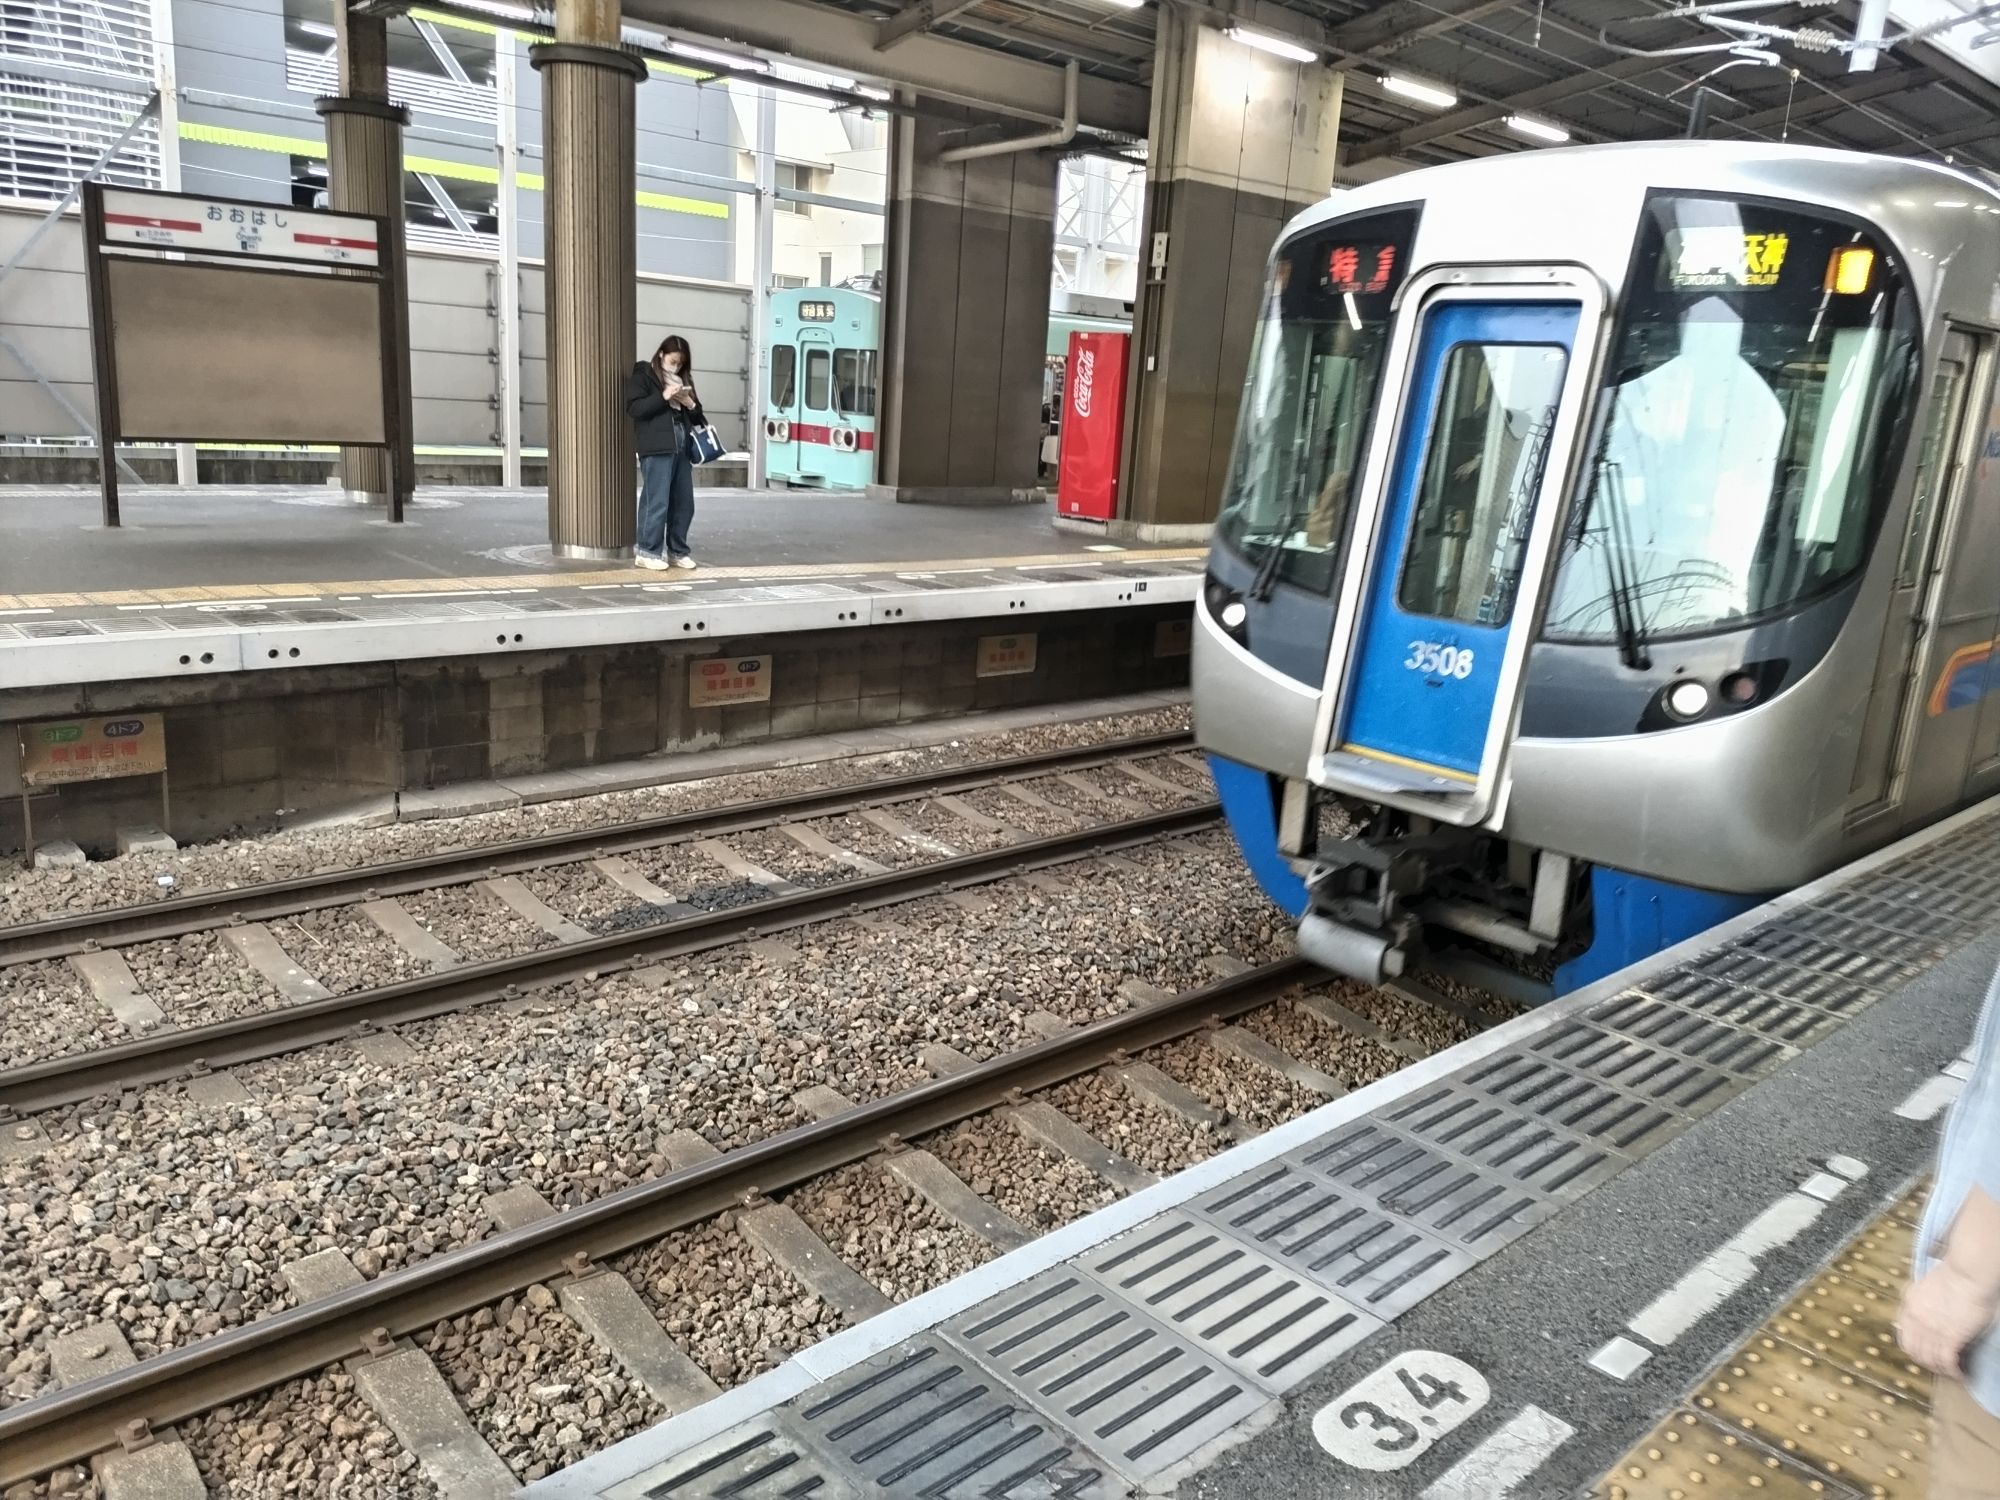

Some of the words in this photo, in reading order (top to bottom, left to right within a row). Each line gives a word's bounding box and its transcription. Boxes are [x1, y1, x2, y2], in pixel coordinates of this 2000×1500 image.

[207, 205, 287, 228] おおはし
[1074, 345, 1095, 418] Coca-Cola
[1403, 640, 1474, 680] 3508
[106, 722, 140, 735] 4ドア
[1340, 1368, 1471, 1452] 3.4
